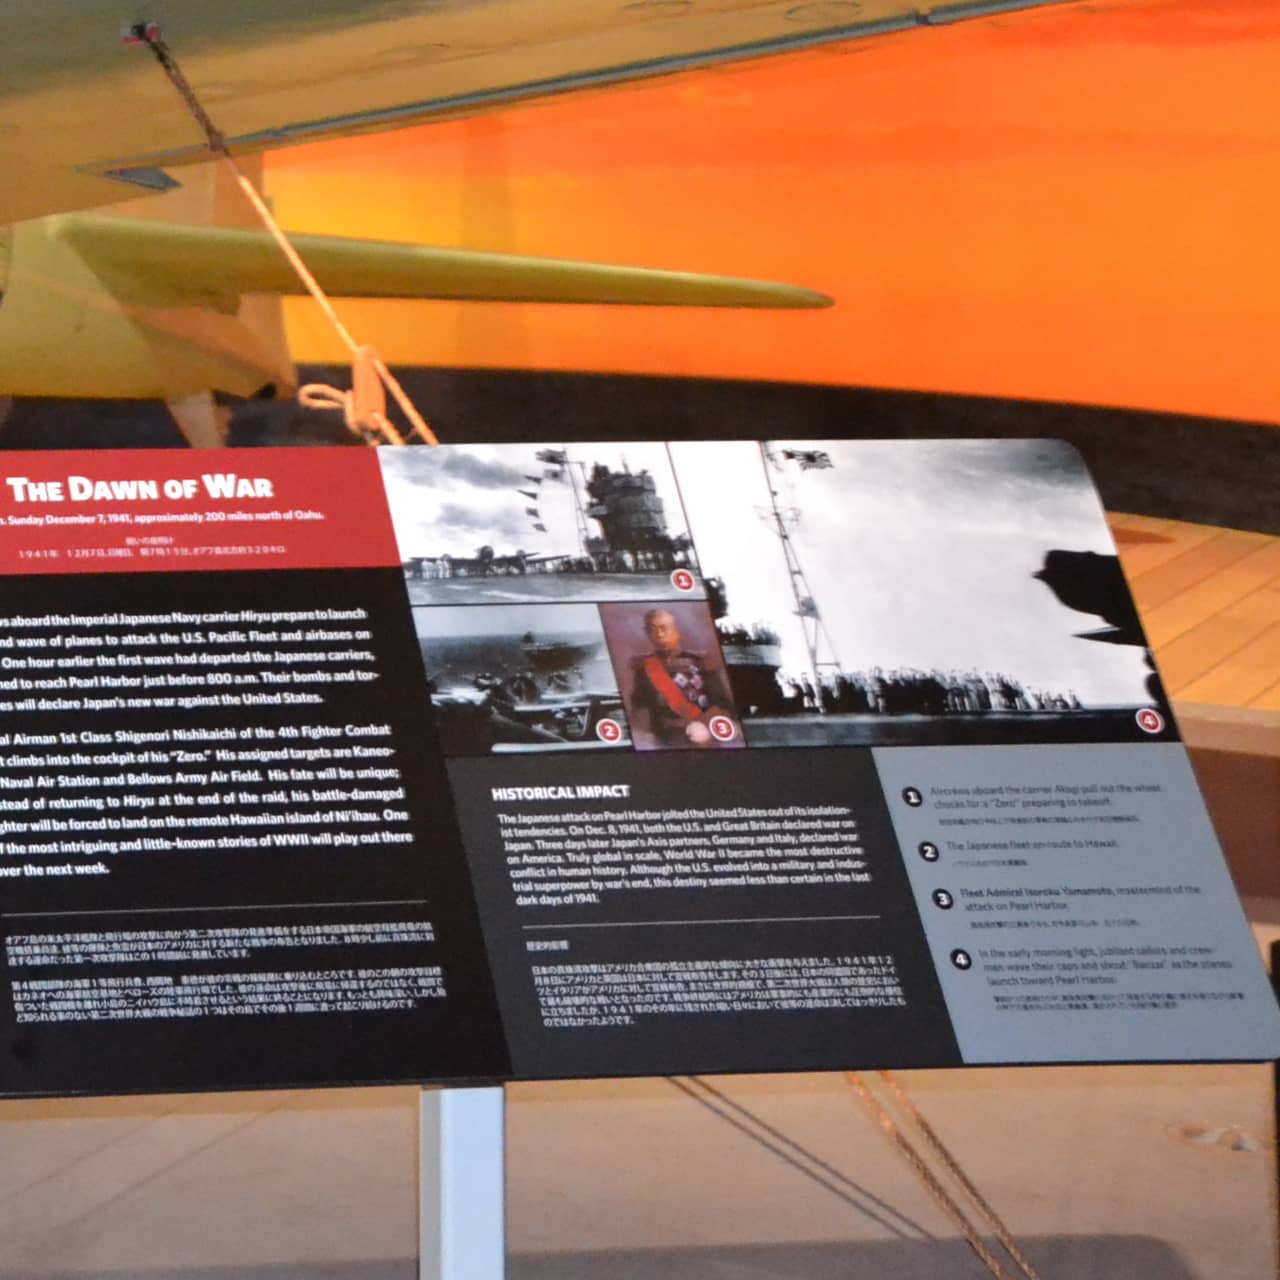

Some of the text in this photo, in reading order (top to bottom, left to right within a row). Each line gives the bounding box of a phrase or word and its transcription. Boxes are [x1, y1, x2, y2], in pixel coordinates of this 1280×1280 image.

[7, 514, 45, 526] Sunday
[44, 514, 96, 524] December
[133, 512, 203, 524] approximately
[204, 511, 226, 521] 200
[225, 511, 254, 521] miles
[253, 510, 282, 520] north
[9, 614, 51, 627] aboard
[49, 614, 71, 626] the
[69, 613, 119, 626] Imperial
[118, 613, 172, 625] Japanese
[170, 611, 202, 624] Navy
[201, 611, 240, 622] carrier
[239, 610, 271, 623] Hiryu
[270, 611, 315, 622] prepare
[313, 609, 328, 620] to
[326, 607, 366, 619] launch
[15, 637, 47, 647] wave
[48, 634, 62, 646] of
[64, 634, 103, 648] planes
[104, 634, 119, 645] to
[121, 633, 157, 645] attack
[159, 632, 180, 644] the
[208, 630, 246, 642] Pacific
[248, 630, 278, 641] Fleet
[280, 629, 303, 641] and
[304, 629, 353, 640] airbases
[354, 630, 370, 640] on
[0, 656, 26, 669] One
[27, 656, 56, 668] hour
[56, 655, 95, 667] earlier
[95, 654, 116, 666] the
[116, 654, 142, 665] first
[141, 655, 174, 665] wave
[174, 652, 198, 664] had
[197, 651, 251, 665] departed
[250, 651, 272, 662] the
[274, 651, 326, 663] Japanese
[18, 678, 34, 689] to
[33, 676, 67, 688] reach
[68, 675, 99, 688] Pearl
[99, 675, 141, 687] Harbor
[142, 674, 166, 688] just
[166, 673, 205, 685] before
[259, 671, 291, 683] Their
[291, 670, 332, 682] bombs
[332, 669, 356, 681] and
[14, 698, 36, 710] will
[36, 697, 81, 710] declare
[126, 698, 152, 707] new
[152, 697, 176, 706] war
[177, 694, 220, 708] against
[220, 693, 241, 705] the
[241, 692, 282, 704] United
[13, 733, 57, 745] Airman
[79, 731, 112, 743] Class
[114, 729, 170, 744] Shigenori
[172, 727, 236, 740] Nishikaichi
[239, 727, 253, 739] of
[254, 726, 275, 738] the
[300, 725, 342, 739] Fighter
[344, 724, 391, 736] Combat
[491, 784, 630, 801] HISTORICAL IMPACT
[907, 791, 920, 804] 1
[923, 846, 935, 858] 2
[22, 863, 44, 876] the
[45, 863, 73, 875] next
[937, 893, 949, 906] 3
[955, 953, 967, 965] 4
